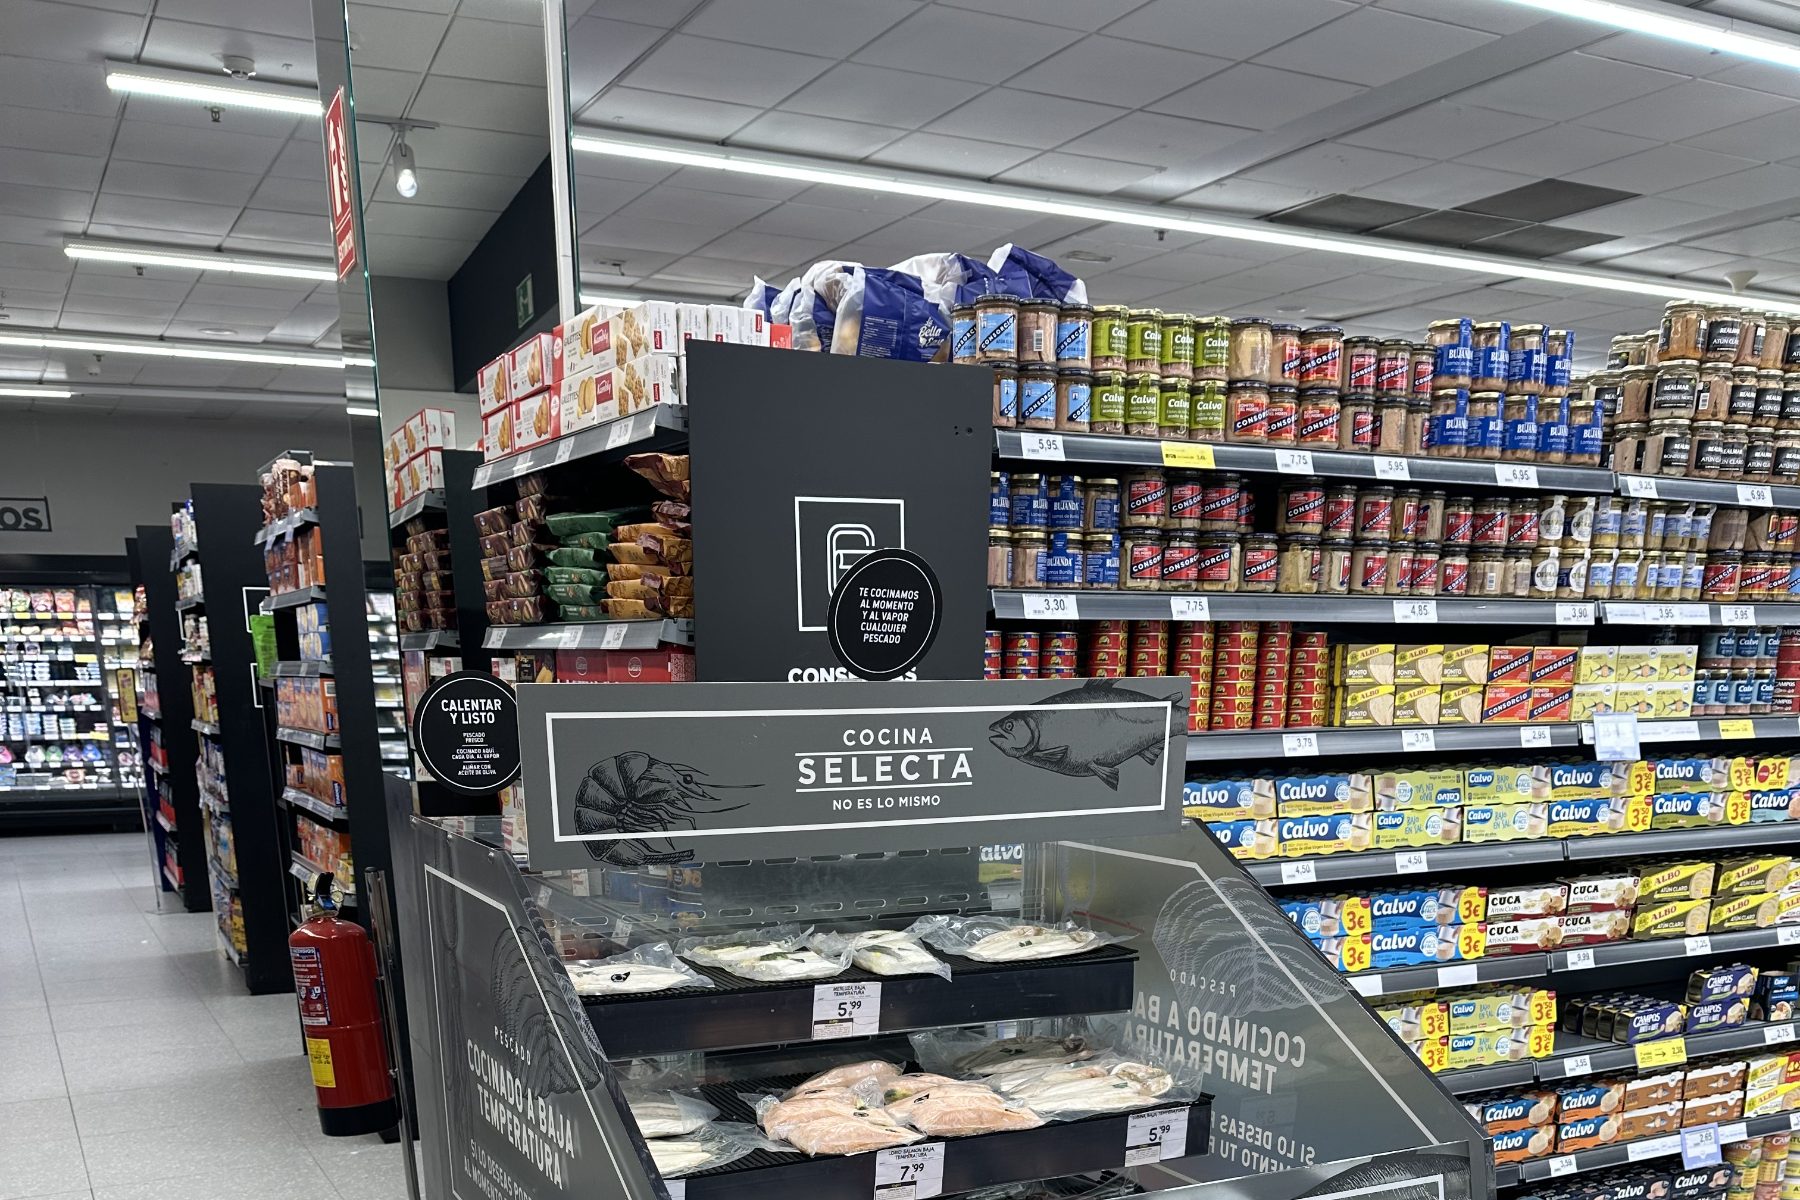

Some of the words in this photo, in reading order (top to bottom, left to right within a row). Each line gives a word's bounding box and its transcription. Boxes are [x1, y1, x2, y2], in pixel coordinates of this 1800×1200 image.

[1130, 394, 1156, 405] Calvo
[1196, 401, 1222, 410] Calvo
[1038, 438, 1058, 451] 5,95
[1290, 454, 1308, 466] 7,75
[1388, 460, 1404, 472] 5,95
[1512, 470, 1530, 482] 6,95
[1054, 501, 1080, 512] BUJANDA
[859, 588, 869, 597] TE
[870, 588, 920, 600] COCINAMOS
[860, 600, 870, 610] AL
[872, 600, 914, 611] MOMENTO
[1044, 598, 1066, 612] 3,30
[1186, 600, 1204, 613] 7,75
[1410, 604, 1428, 618] 4,85
[862, 610, 868, 620] Y
[869, 611, 880, 621] AL
[882, 612, 909, 622] VAPOR
[1572, 608, 1588, 620] 3,90
[1659, 609, 1674, 620] 3,95
[1734, 610, 1748, 620] 5,95
[860, 622, 906, 633] CUALQUIER
[863, 634, 901, 644] PESCADO
[1360, 646, 1380, 658] ALBO
[1408, 648, 1428, 658] ALBO
[1455, 647, 1474, 658] ALBO
[1493, 655, 1530, 678] CONSORCIO
[1536, 655, 1574, 678] CONSORCIO
[788, 667, 918, 683] CONSS
[1360, 688, 1380, 700] ALBO
[1408, 688, 1427, 699] ALBO
[1452, 687, 1470, 698] ALBO
[441, 698, 502, 712] CALENTAR
[1488, 692, 1528, 716] CONSORCIO
[1534, 693, 1570, 716] CONSORCIO
[450, 712, 458, 725] Y
[462, 712, 496, 725] LISTO
[843, 728, 933, 746] COCINA
[1296, 737, 1312, 748] 3,79
[1414, 732, 1430, 744] 3,79
[1532, 731, 1546, 740] 2,95
[798, 753, 973, 785] SELECTA
[1656, 764, 1694, 778] Calvo
[1470, 773, 1492, 784] Calvo
[1554, 769, 1593, 786] Calvo
[1280, 782, 1327, 800] Calvo
[1437, 792, 1460, 802] Calvo
[833, 800, 852, 810] NO
[857, 798, 872, 809] ES
[877, 798, 894, 808] LO
[899, 795, 940, 807] MISMO
[1655, 798, 1692, 814] Calvo
[1752, 792, 1788, 808] Calvo
[1468, 810, 1492, 821] Calvo
[1552, 804, 1591, 820] Calvo
[1378, 814, 1402, 826] Calvo
[1282, 820, 1329, 840] Calvo
[1408, 856, 1422, 866] 4,50
[1296, 864, 1311, 874] 4,50
[1734, 864, 1760, 880] ALBO
[1654, 869, 1681, 884] ALBO
[1573, 885, 1599, 895] CUCA
[1372, 900, 1416, 916] Calvo
[1491, 896, 1521, 906] CUCA
[1725, 900, 1750, 915] ALBO
[1462, 900, 1480, 919] 3€
[1652, 906, 1677, 920] ALBO
[1346, 911, 1365, 931] 3€
[1565, 916, 1590, 926] CUCA
[1489, 926, 1519, 936] CUCA
[1372, 934, 1416, 951] Calvo
[1462, 936, 1480, 955] 3€
[1346, 946, 1364, 966] 3€
[1707, 974, 1733, 989] CAMPOS
[1453, 1004, 1474, 1015] Calvo
[1693, 1004, 1722, 1018] CAMPOS
[1633, 1012, 1660, 1028] CAMPOS
[494, 1025, 531, 1066] PESCADO
[1452, 1038, 1474, 1048] Calvo
[467, 1039, 524, 1113] COCINADO
[527, 1088, 536, 1125] A
[538, 1096, 575, 1159] BAJA
[1562, 1094, 1596, 1110] Calvo
[1486, 1104, 1524, 1122] Calvo
[477, 1083, 563, 1190] TEMPERATURA
[1561, 1123, 1595, 1140] Calvo
[464, 1156, 472, 1178] AL
[470, 1138, 480, 1160] SI
[480, 1149, 486, 1169] LO
[488, 1155, 512, 1196] DESEAS
[1675, 1174, 1708, 1190] Calvo
